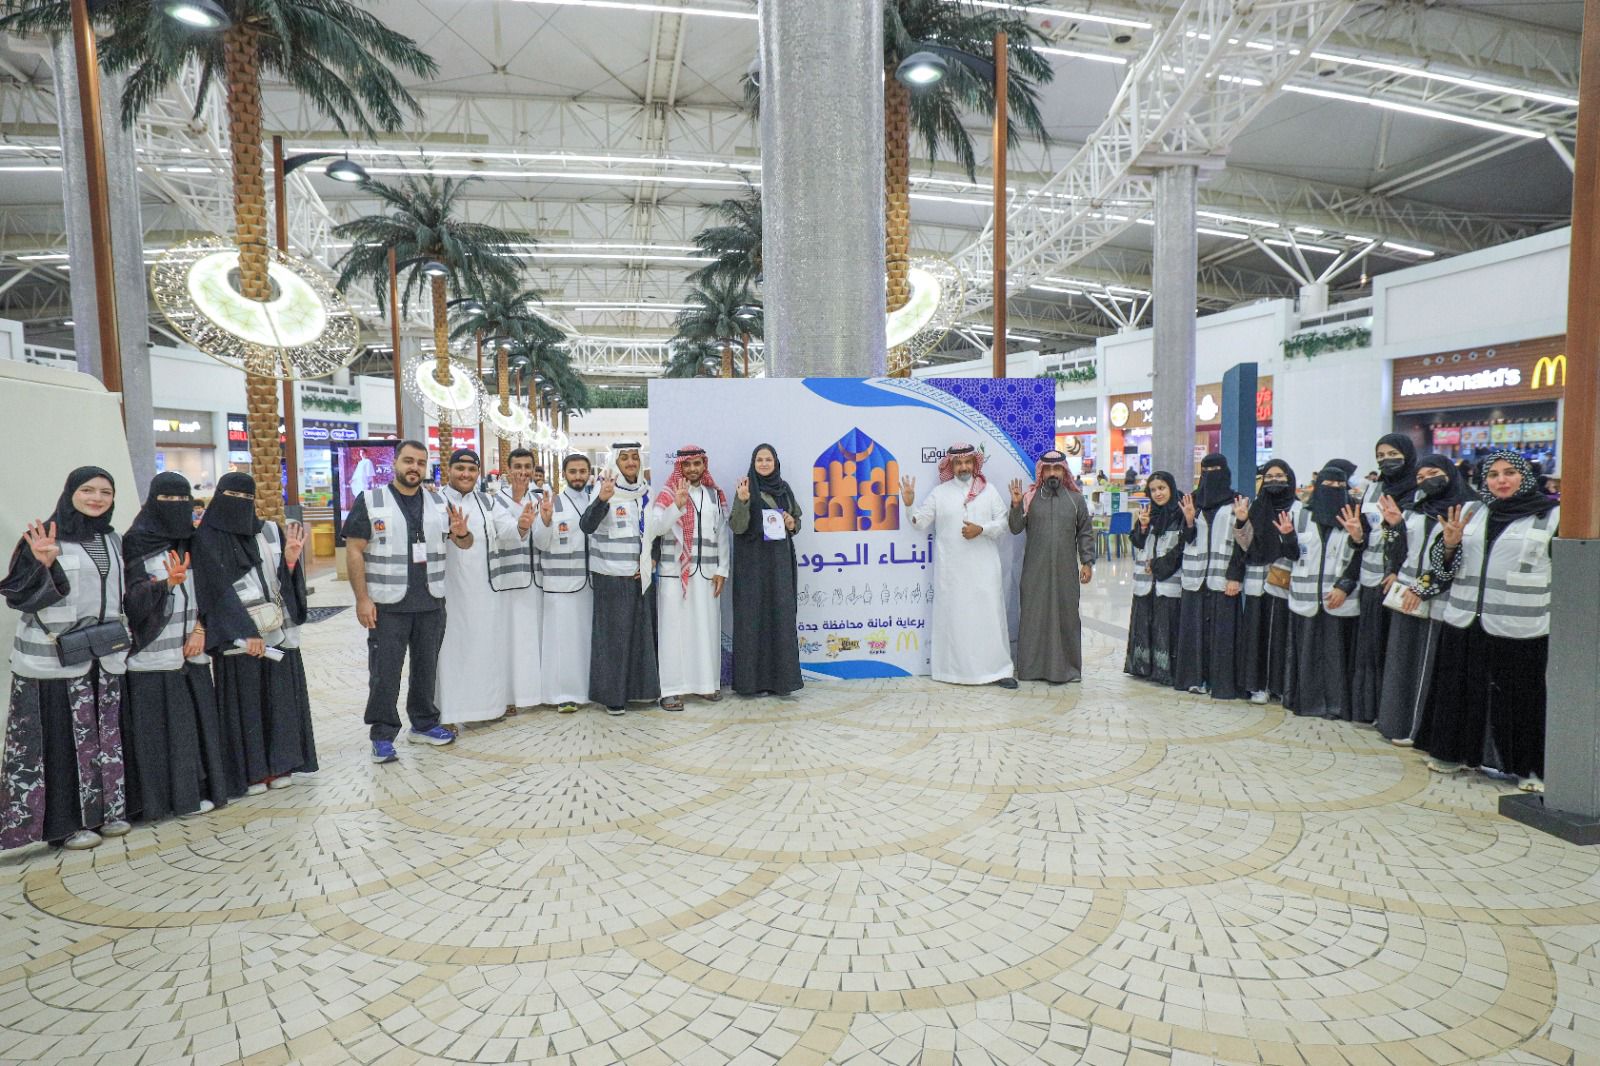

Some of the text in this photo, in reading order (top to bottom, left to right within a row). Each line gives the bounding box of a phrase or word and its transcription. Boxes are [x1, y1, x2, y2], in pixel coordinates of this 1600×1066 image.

[1400, 367, 1521, 396] McDonald's
[798, 533, 933, 572] أبناء الجود
[798, 616, 925, 632] برعاية أمانة محافظة جدة
